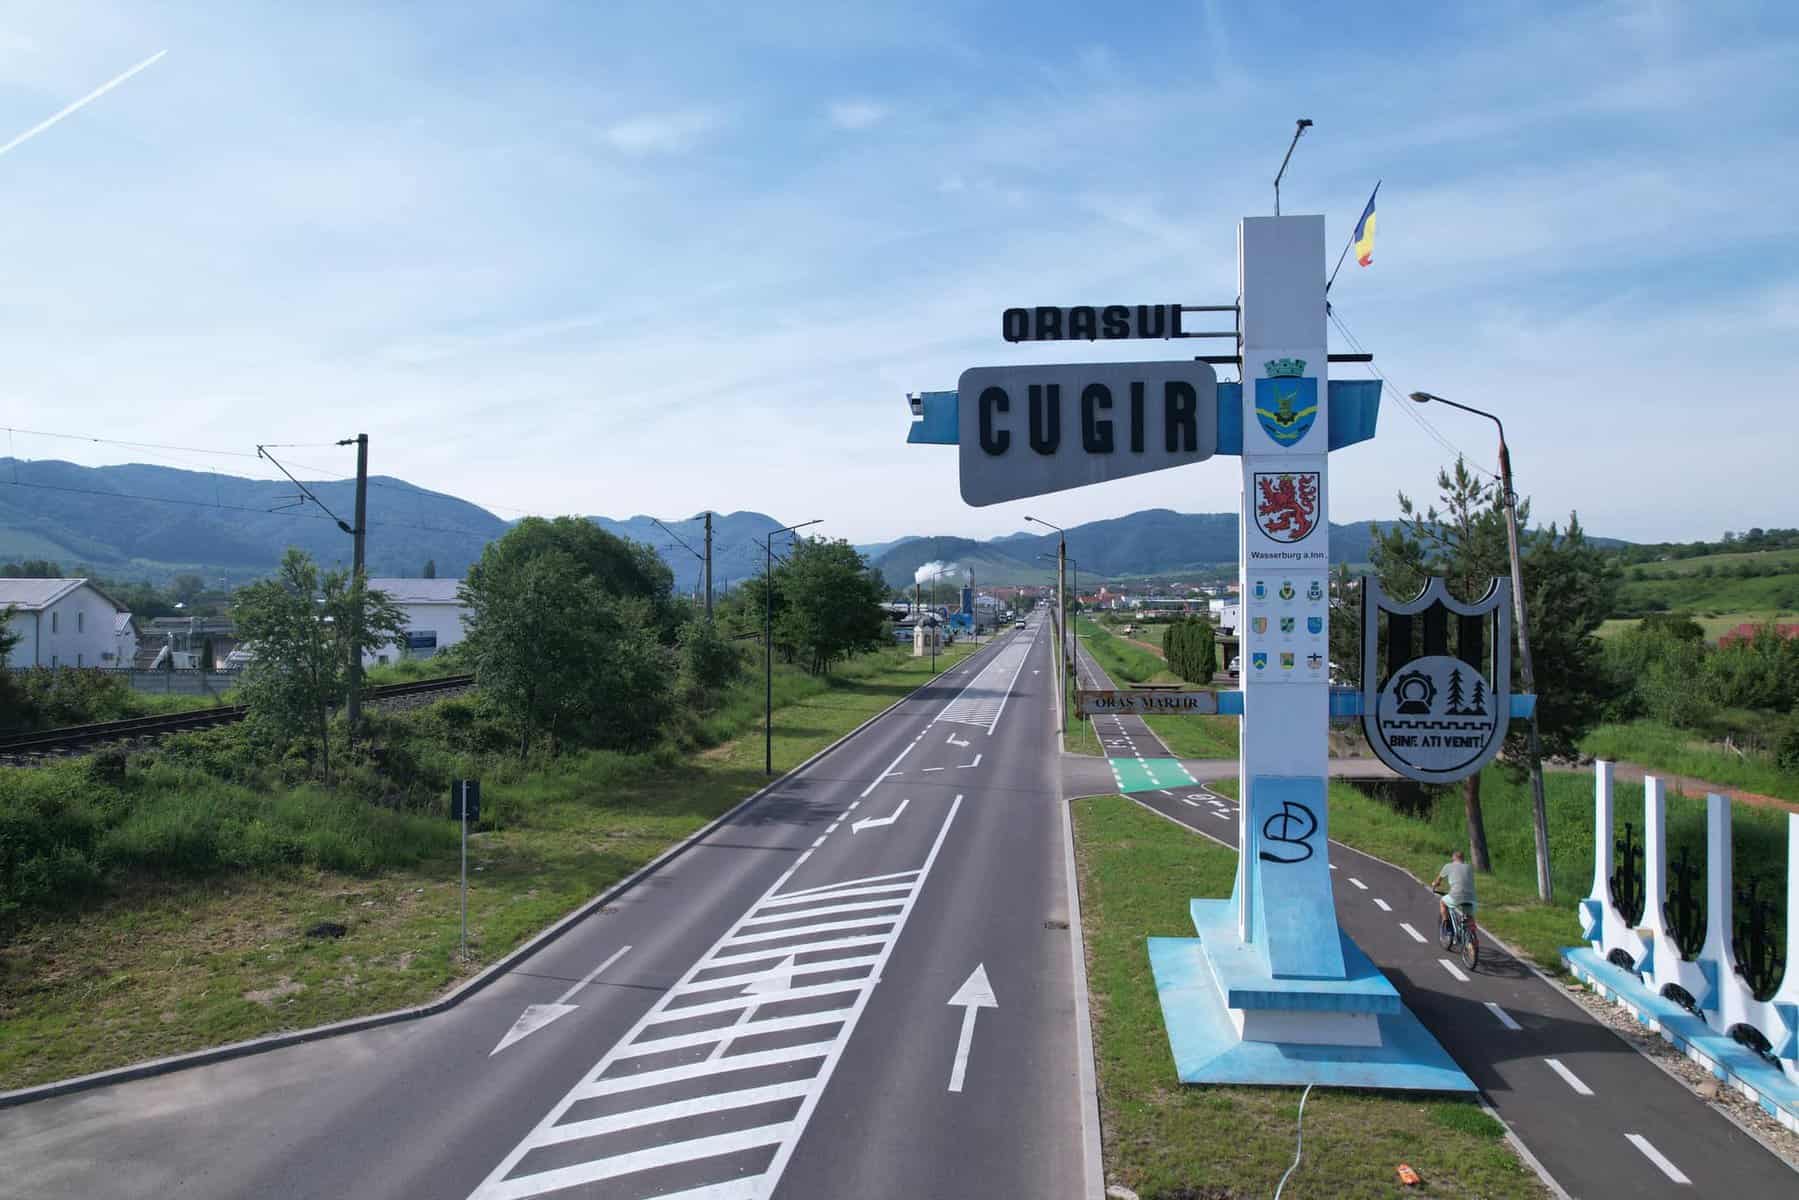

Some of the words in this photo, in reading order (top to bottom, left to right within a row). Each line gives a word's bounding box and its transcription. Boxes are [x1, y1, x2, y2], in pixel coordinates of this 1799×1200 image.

[1003, 304, 1187, 342] ORASUL
[979, 381, 1197, 456] CUGIR
[1250, 551, 1301, 560] Wasserburg
[1095, 697, 1136, 708] ORAS
[1422, 736, 1441, 748] ATI
[1443, 734, 1484, 749] VENIT!
